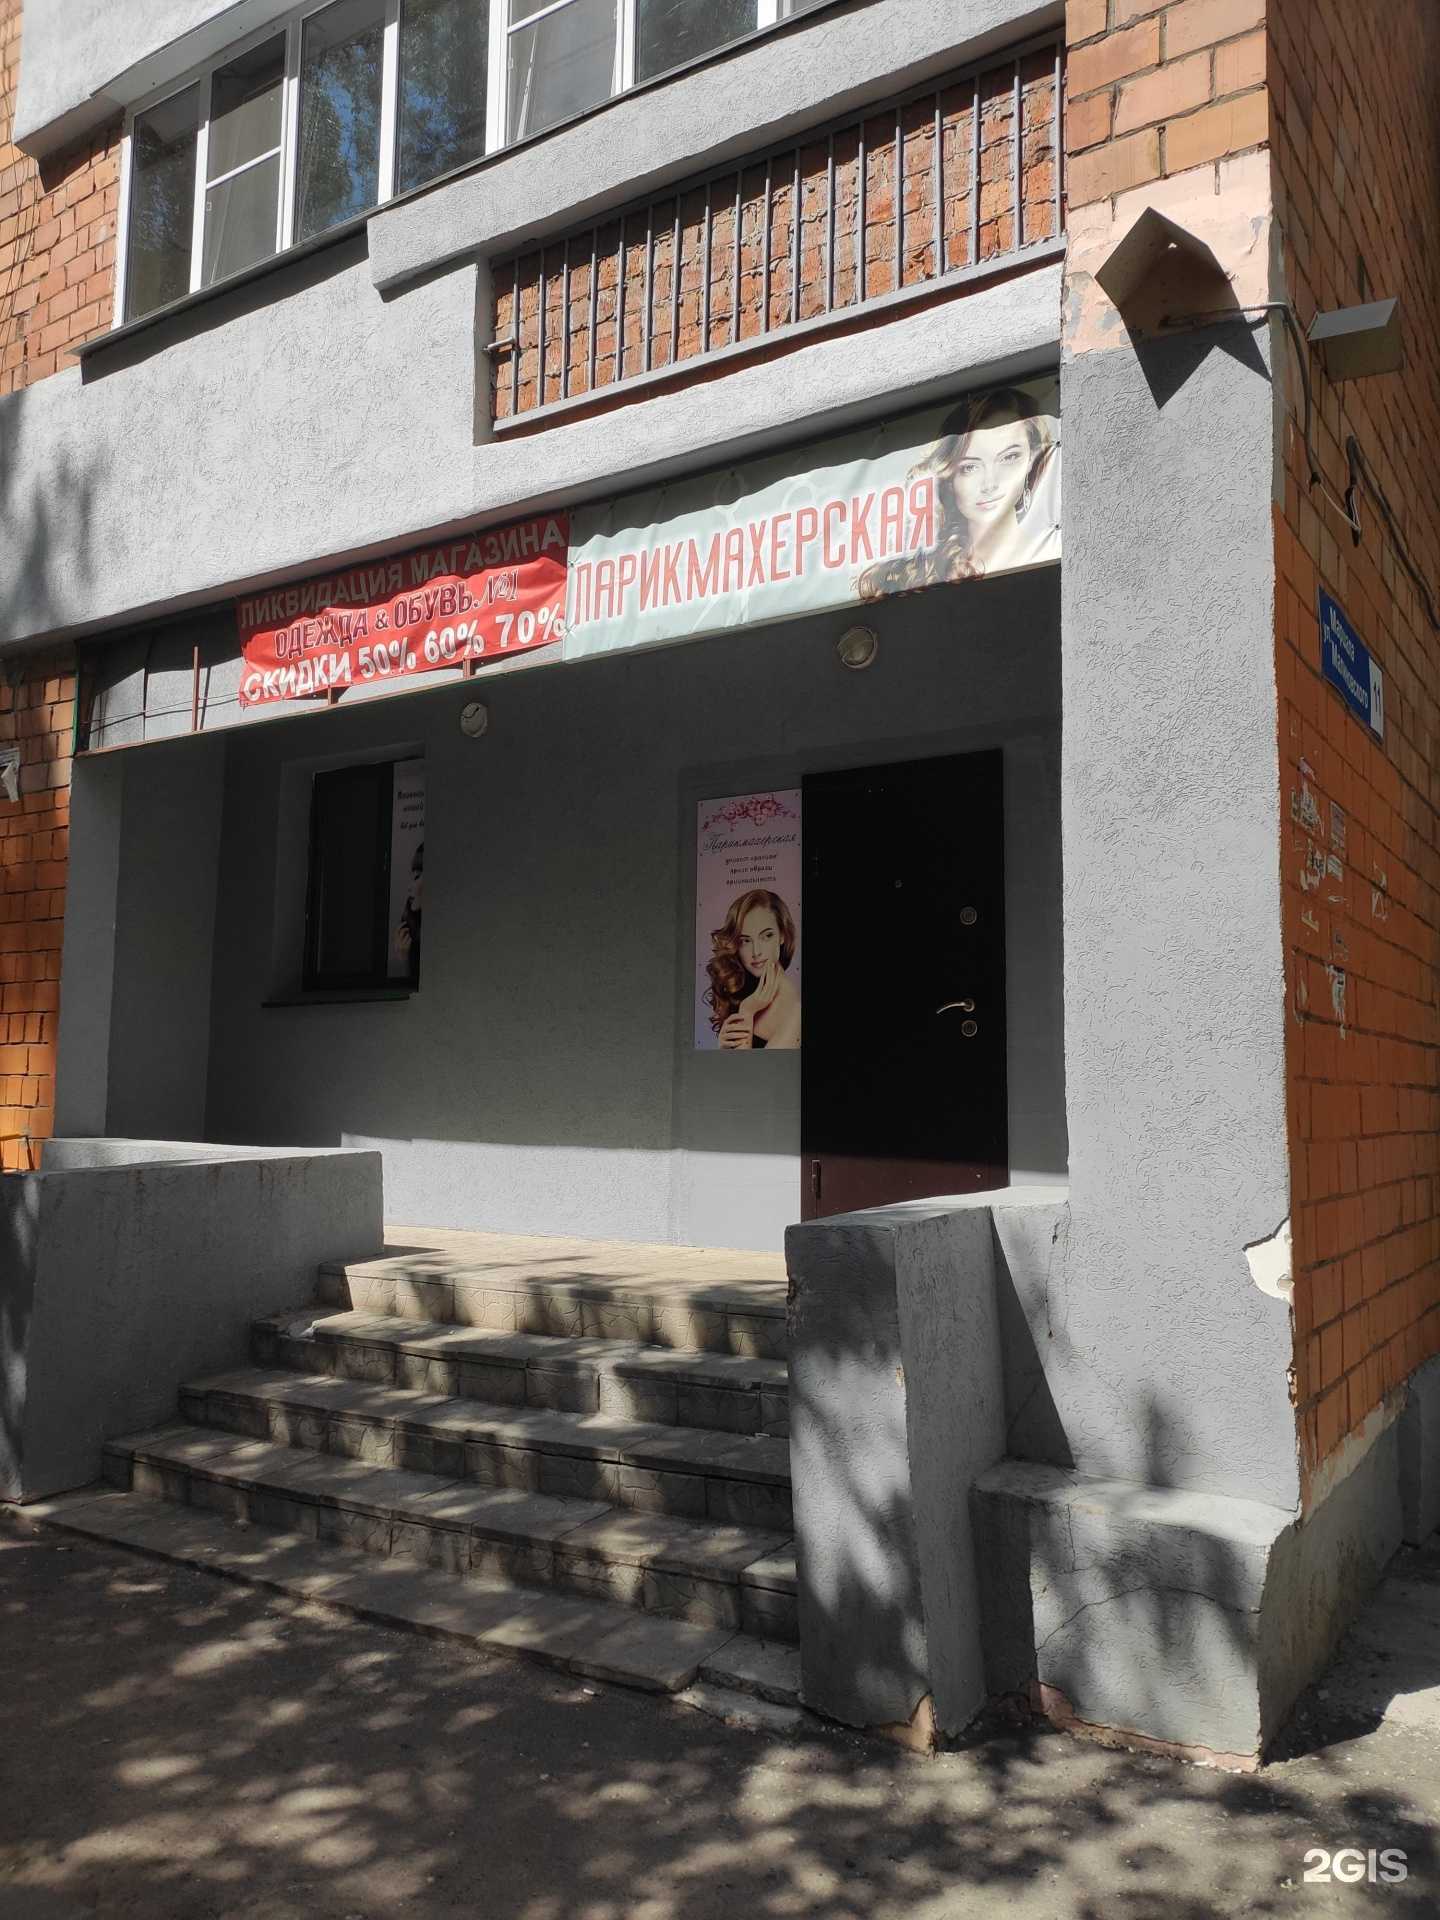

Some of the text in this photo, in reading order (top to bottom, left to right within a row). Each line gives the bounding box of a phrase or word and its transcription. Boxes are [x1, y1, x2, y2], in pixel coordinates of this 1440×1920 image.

[241, 519, 566, 628] ЛИКВИДАЦИЯ МАГАЗИНА
[574, 477, 935, 626] ПАРИКМАХЕРСКАЯ
[242, 603, 566, 702] СКИДКИ 50% 60% 70%
[274, 610, 369, 660] ОДЕЖДА
[375, 609, 390, 630] &
